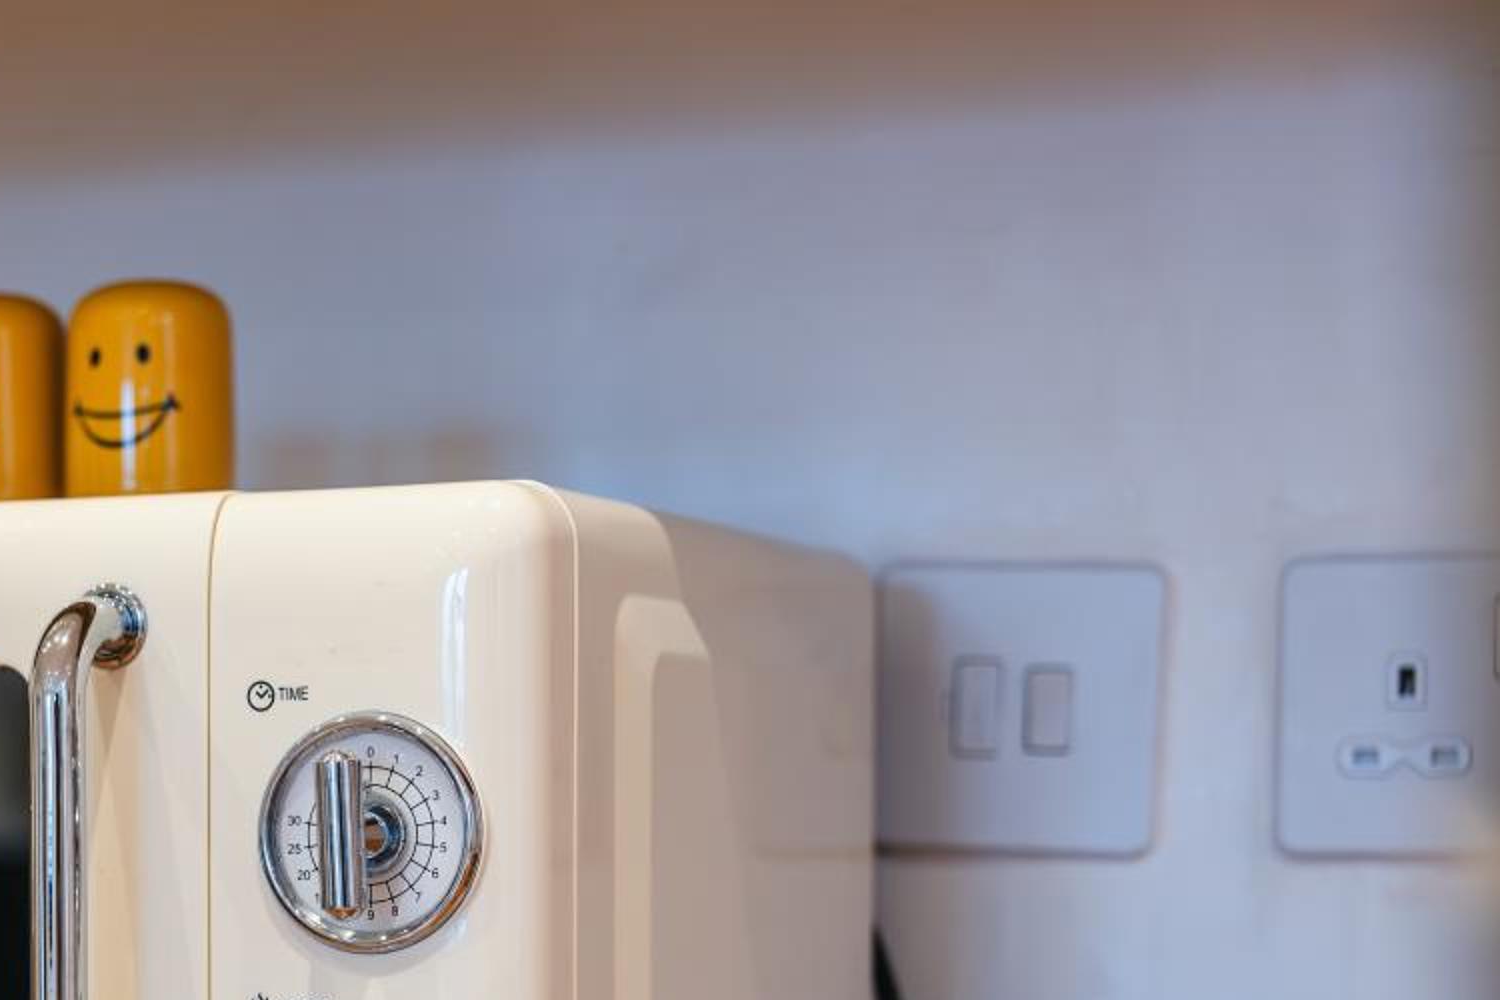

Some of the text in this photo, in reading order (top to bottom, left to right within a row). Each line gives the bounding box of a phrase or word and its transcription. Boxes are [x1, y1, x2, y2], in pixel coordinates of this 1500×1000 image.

[279, 684, 308, 701] TIME
[367, 746, 375, 758] 0
[393, 754, 399, 764] 1
[415, 765, 423, 777] 2
[433, 790, 440, 801] 3
[287, 815, 302, 827] 30
[439, 815, 447, 826] 4
[287, 843, 302, 855] 25
[439, 842, 447, 853] 5
[297, 869, 311, 881] 20
[432, 867, 439, 879] 6
[367, 910, 375, 921] 9
[391, 906, 399, 917] 8
